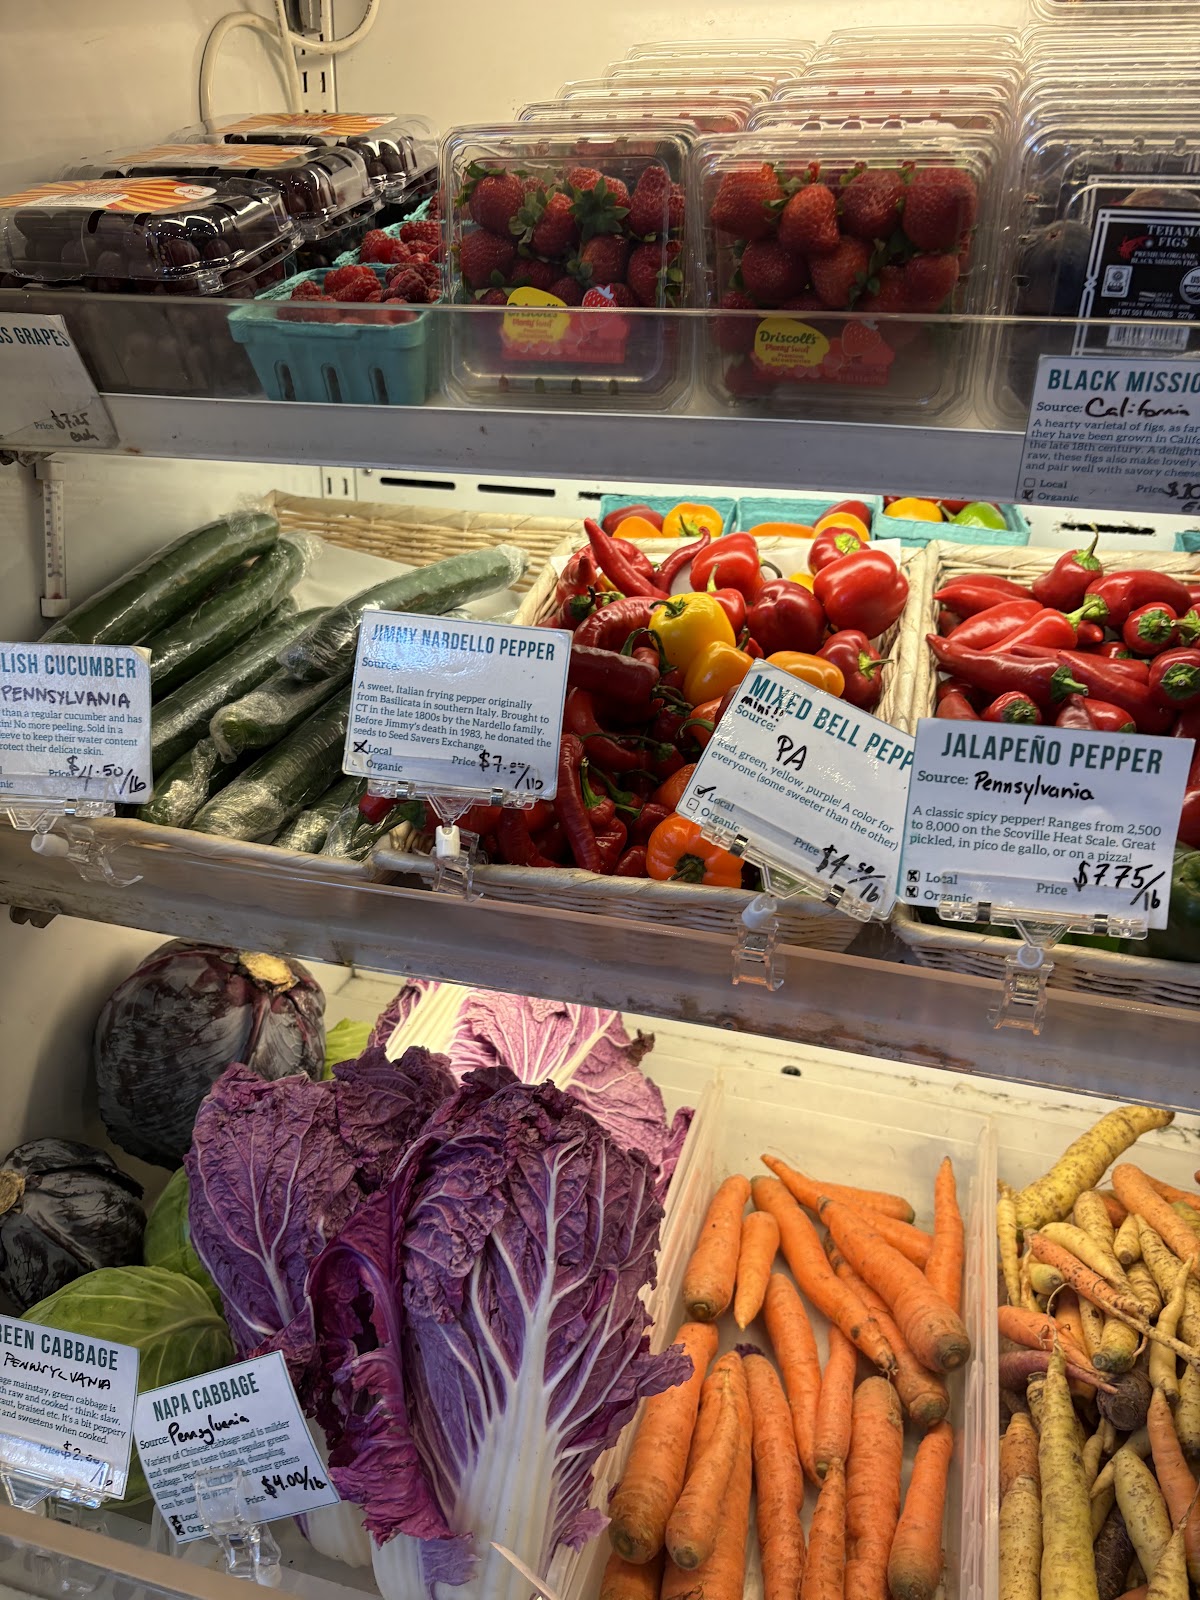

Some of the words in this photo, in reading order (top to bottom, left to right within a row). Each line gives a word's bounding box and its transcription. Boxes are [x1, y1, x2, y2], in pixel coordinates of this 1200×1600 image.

[1158, 236, 1189, 248] FIGS
[13, 326, 70, 347] GRAPES
[759, 330, 816, 345] Driscoll's
[1047, 368, 1120, 392] BLACK
[1036, 401, 1083, 413] Source:
[34, 421, 55, 430] Price
[1033, 418, 1042, 427] A
[1045, 419, 1082, 430] hearty
[1085, 421, 1127, 430] varietal
[1129, 422, 1143, 430] of
[1143, 422, 1166, 433] figs,
[1183, 423, 1200, 433] far
[1040, 479, 1068, 489] Local
[1136, 484, 1164, 494] Price
[1037, 492, 1080, 502] Organic
[371, 623, 418, 644] JIMMY
[421, 629, 495, 654] NARDELLO
[499, 638, 555, 661] PEPPER
[1, 652, 39, 674] LISH
[44, 654, 137, 678] CUCUMBER
[1, 685, 131, 708] PENNSYLVANIA
[357, 680, 366, 689] A
[367, 682, 395, 693] sweet,
[396, 685, 424, 697] Italian
[426, 688, 455, 702] frying
[456, 693, 487, 704] pepper
[488, 697, 533, 711] originally
[2, 707, 23, 717] than
[31, 710, 63, 720] regular
[64, 711, 107, 721] cucumber
[109, 713, 125, 722] and
[127, 714, 143, 724] has
[356, 692, 378, 702] from
[379, 694, 421, 708] Basilicata
[423, 700, 432, 709] in
[433, 703, 474, 715] southern
[475, 706, 499, 719] Italy.
[501, 709, 538, 722] Brought
[539, 714, 550, 724] to
[735, 704, 776, 732] Source:
[748, 674, 813, 721] MIXED
[812, 707, 861, 747] BELL
[863, 732, 914, 771] PEPP
[353, 726, 377, 737] seeds
[378, 729, 387, 738] to
[388, 730, 409, 741] Seed
[410, 733, 440, 745] Savers
[368, 744, 392, 755] Local
[451, 755, 476, 767] Price
[775, 734, 808, 771] PA
[941, 732, 1061, 766] JALAPEÑO
[1069, 742, 1163, 774] PEPPER
[48, 769, 71, 777] Price
[366, 759, 403, 773] Organic
[739, 750, 768, 772] green,
[771, 766, 805, 790] yellow,
[805, 784, 843, 808] purple!
[841, 802, 851, 813] A
[851, 808, 878, 827] color
[878, 820, 894, 834] for
[917, 770, 969, 785] Source:
[974, 770, 1095, 805] Pennsylvania
[707, 792, 736, 812] Local
[711, 750, 757, 778] everyone
[756, 772, 786, 793] (some
[785, 789, 825, 812] sweeter
[825, 807, 849, 826] than
[850, 820, 867, 835] the
[867, 832, 899, 852] other)
[700, 807, 740, 833] Organic
[912, 805, 922, 816] A
[925, 806, 964, 819] classic
[966, 811, 998, 823] spicy
[1000, 814, 1046, 827] pepper!
[1048, 816, 1092, 831] Ranges
[1094, 820, 1124, 833] from
[1127, 823, 1162, 837] 2,500
[793, 836, 820, 856] Price
[911, 819, 924, 830] to
[925, 820, 960, 833] 8,000
[962, 825, 978, 835] on
[981, 825, 1001, 837] the
[1003, 827, 1051, 841] Scoville
[1053, 832, 1083, 845] Heat
[1085, 834, 1119, 848] Scale.
[1121, 838, 1156, 851] Great
[909, 833, 955, 848] pickled,
[958, 837, 970, 848] in
[973, 839, 999, 852] pico
[1000, 841, 1016, 853] de
[1017, 844, 1050, 857] gallo,
[1052, 848, 1068, 857] or
[1069, 849, 1085, 859] on
[1087, 851, 1095, 860] a
[1096, 851, 1133, 864] pizza!
[925, 872, 958, 885] Local
[1036, 882, 1068, 895] Price
[923, 889, 973, 903] Organic
[0, 1323, 35, 1350] EEN
[41, 1333, 119, 1371] CABBAGE
[13, 1380, 51, 1396] mainstay,
[52, 1390, 75, 1403] green
[75, 1395, 108, 1412] cabbage
[109, 1403, 117, 1413] is
[152, 1392, 192, 1422] NAPA
[192, 1372, 260, 1410] CABBAGE
[2, 1409, 17, 1420] and
[17, 1413, 54, 1430] sweetens
[55, 1422, 78, 1437] when
[78, 1430, 109, 1445] cooked.
[139, 1435, 169, 1450] Source:
[144, 1454, 172, 1467] Variety
[172, 1450, 180, 1460] of
[180, 1444, 211, 1458] Chinese
[241, 1428, 256, 1440] and
[256, 1427, 264, 1436] is
[264, 1420, 290, 1433] milder
[245, 1495, 266, 1505] Price
[261, 1465, 328, 1499] $4.00/lb
[181, 1509, 199, 1522] Local
